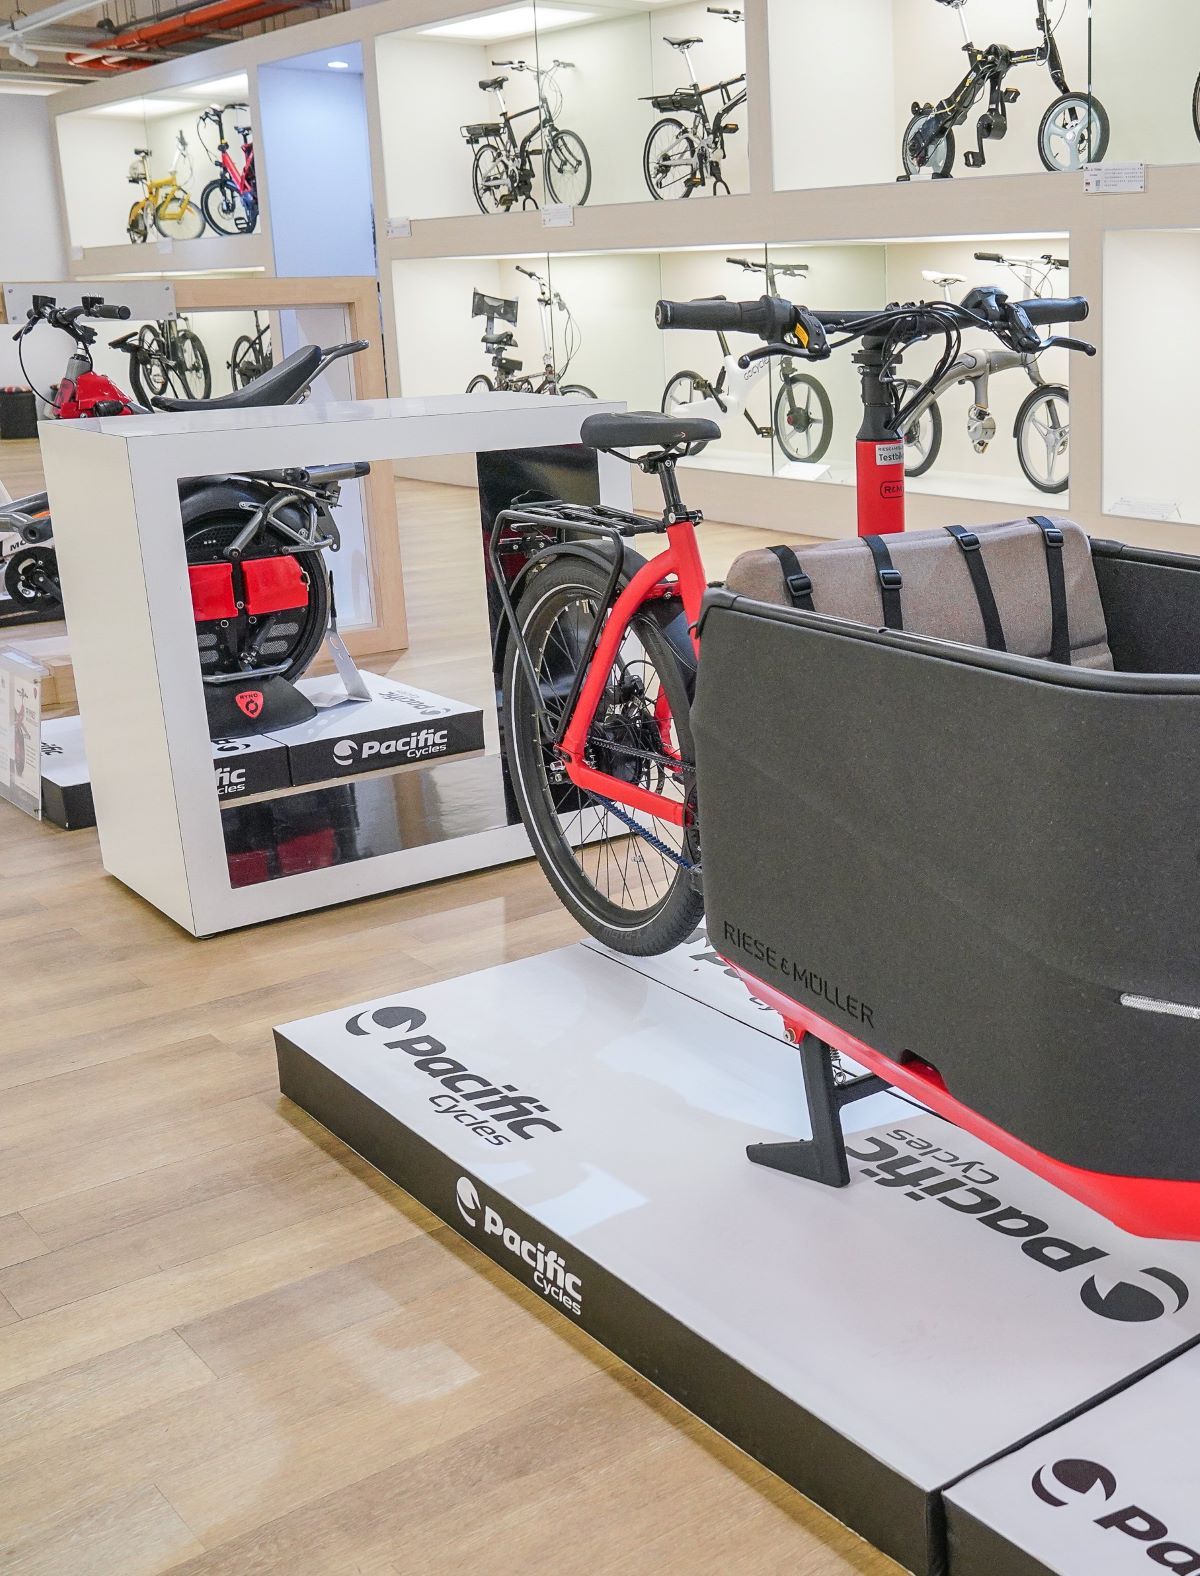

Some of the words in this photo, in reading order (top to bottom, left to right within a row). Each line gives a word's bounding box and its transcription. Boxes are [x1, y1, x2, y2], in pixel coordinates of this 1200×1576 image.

[362, 728, 448, 758] Pacific
[407, 744, 447, 758] Cycles
[217, 784, 246, 795] cles
[724, 921, 778, 970] RIESE
[793, 962, 875, 1029] MÜLLER
[383, 1034, 563, 1141] Pacific
[428, 1094, 512, 1146] Cycles
[886, 1129, 1000, 1185] Cycles
[845, 1136, 1111, 1273] Pacific
[484, 1205, 582, 1302] Pacific
[533, 1270, 582, 1316] Cycles
